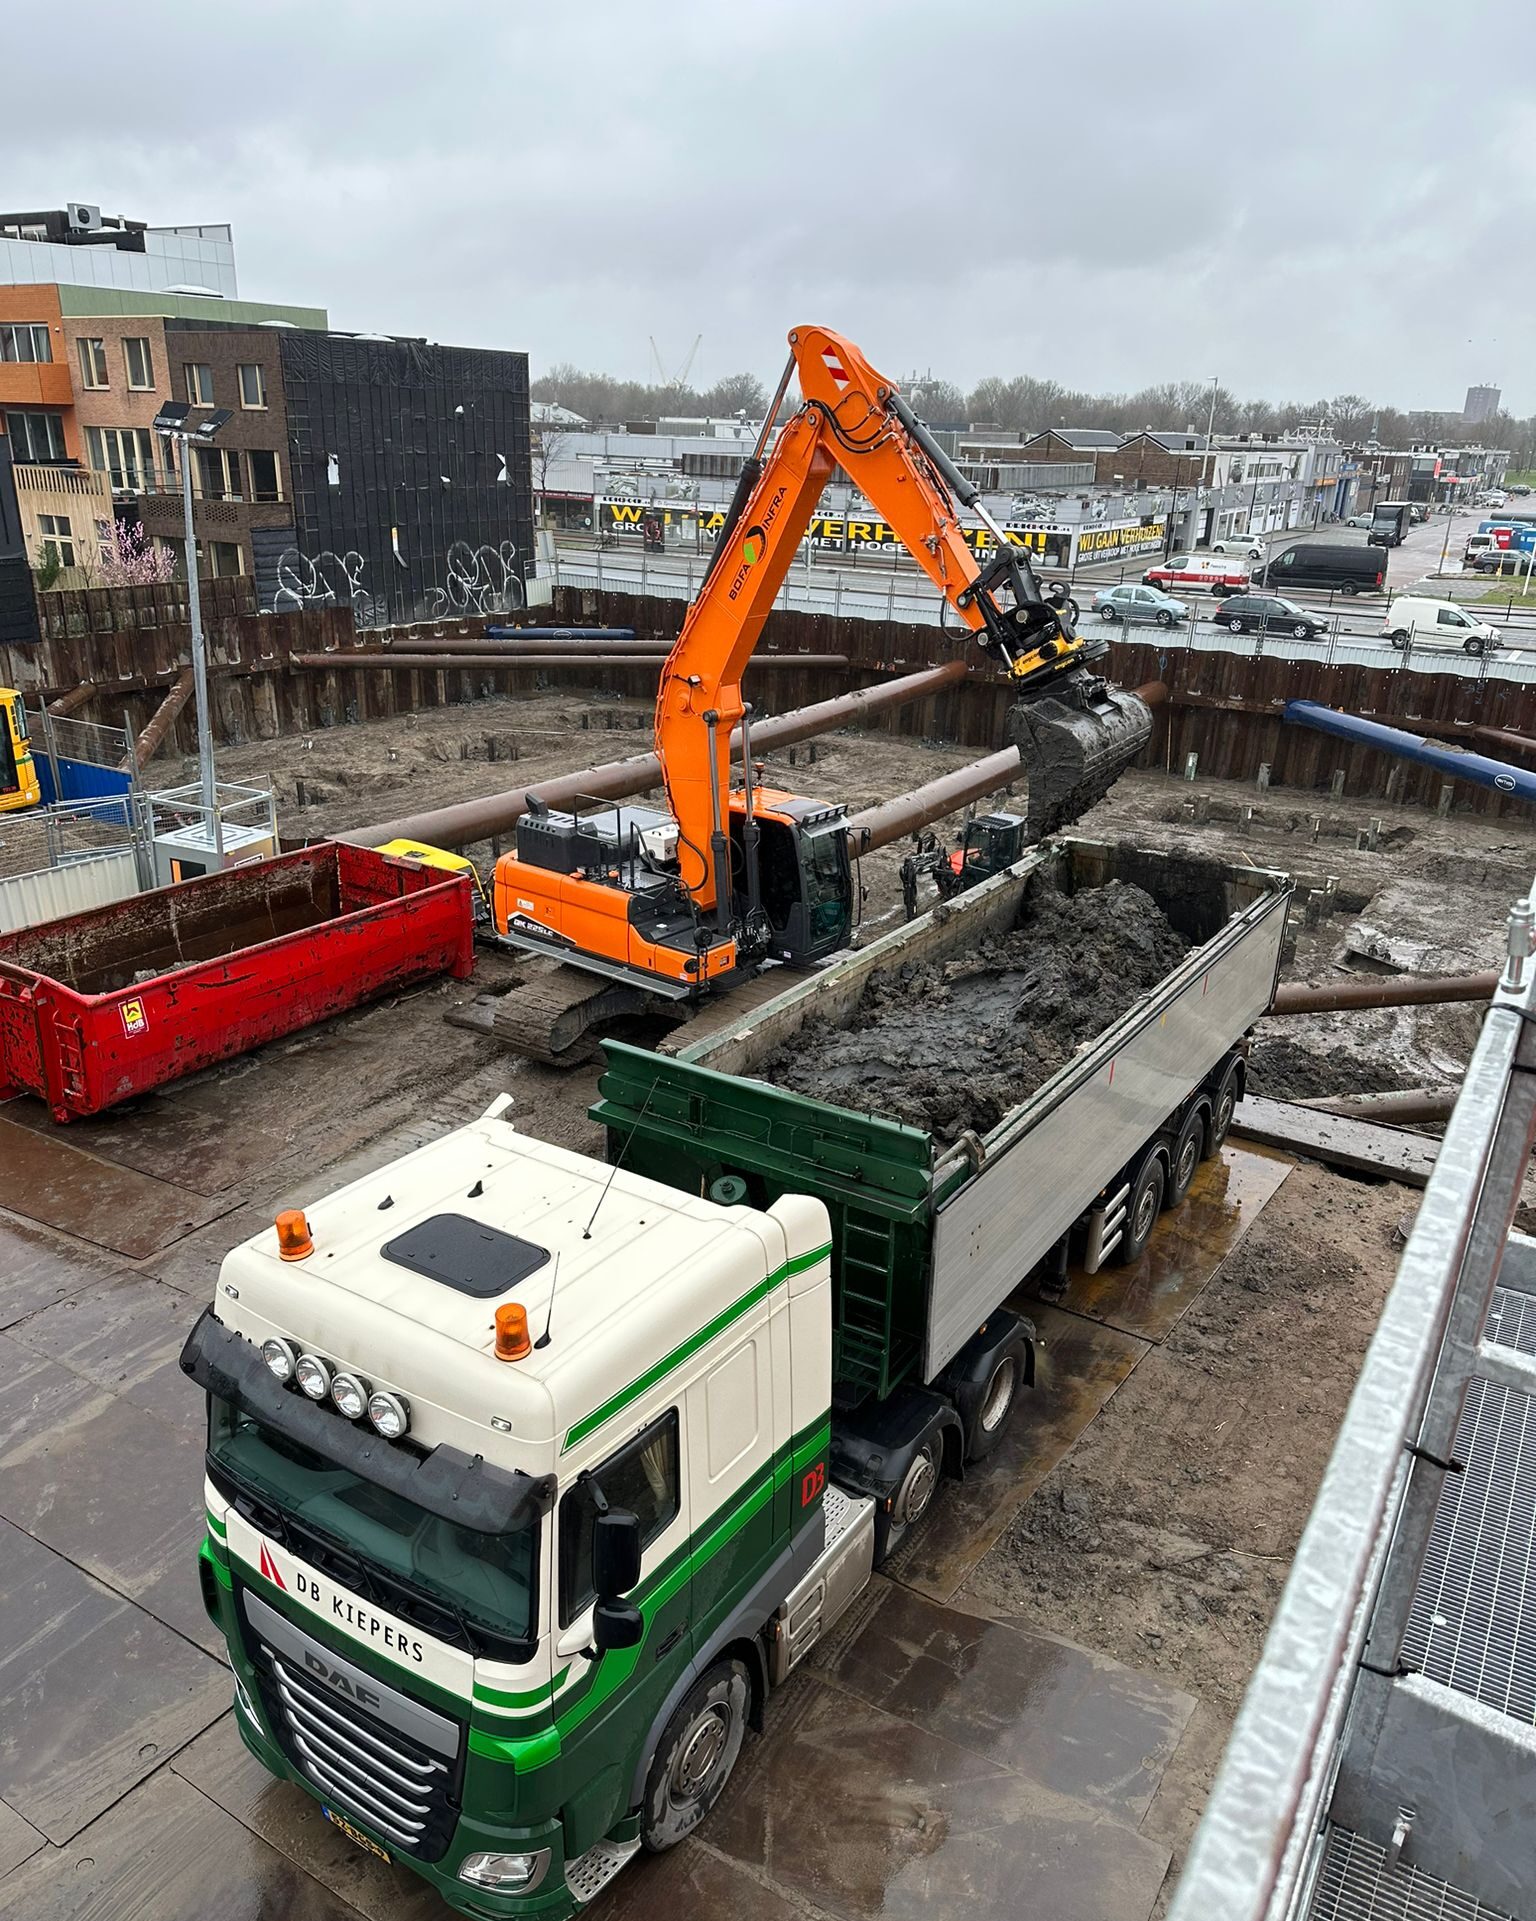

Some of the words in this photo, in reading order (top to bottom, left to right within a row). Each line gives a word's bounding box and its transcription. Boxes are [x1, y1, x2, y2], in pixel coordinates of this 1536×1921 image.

[729, 564, 750, 600] BOFA
[762, 487, 787, 530] INFRA
[802, 537, 844, 549] MET
[851, 540, 909, 553] HOGE
[1079, 533, 1095, 552] WIJ
[1096, 530, 1119, 549] GAAN
[297, 1572, 320, 1602] DB
[333, 1595, 422, 1662] KIEPERS
[305, 1650, 380, 1709] DAF
